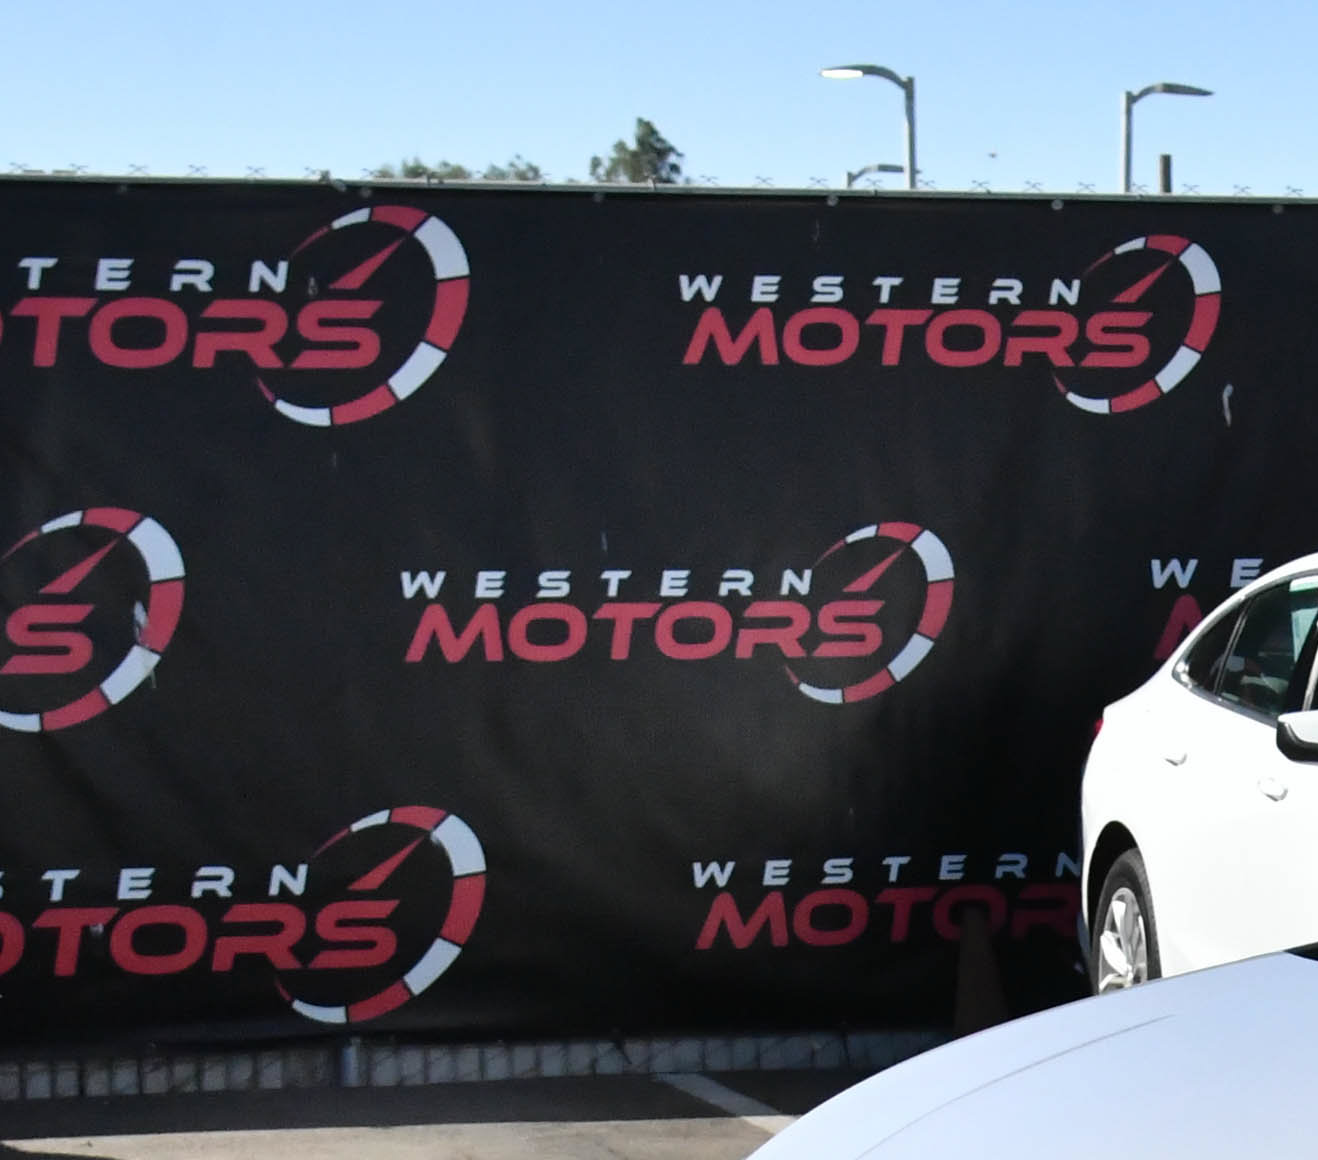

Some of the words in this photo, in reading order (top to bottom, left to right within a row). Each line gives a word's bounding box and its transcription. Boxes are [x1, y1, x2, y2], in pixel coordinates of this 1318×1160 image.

[679, 274, 1081, 306] WESTERN
[0, 298, 379, 369] TORS
[684, 306, 1154, 368] MOTORS
[401, 568, 812, 599] WESTERN
[405, 599, 884, 662] MOTORS
[0, 864, 308, 901] TERN
[0, 900, 400, 976] TORS
